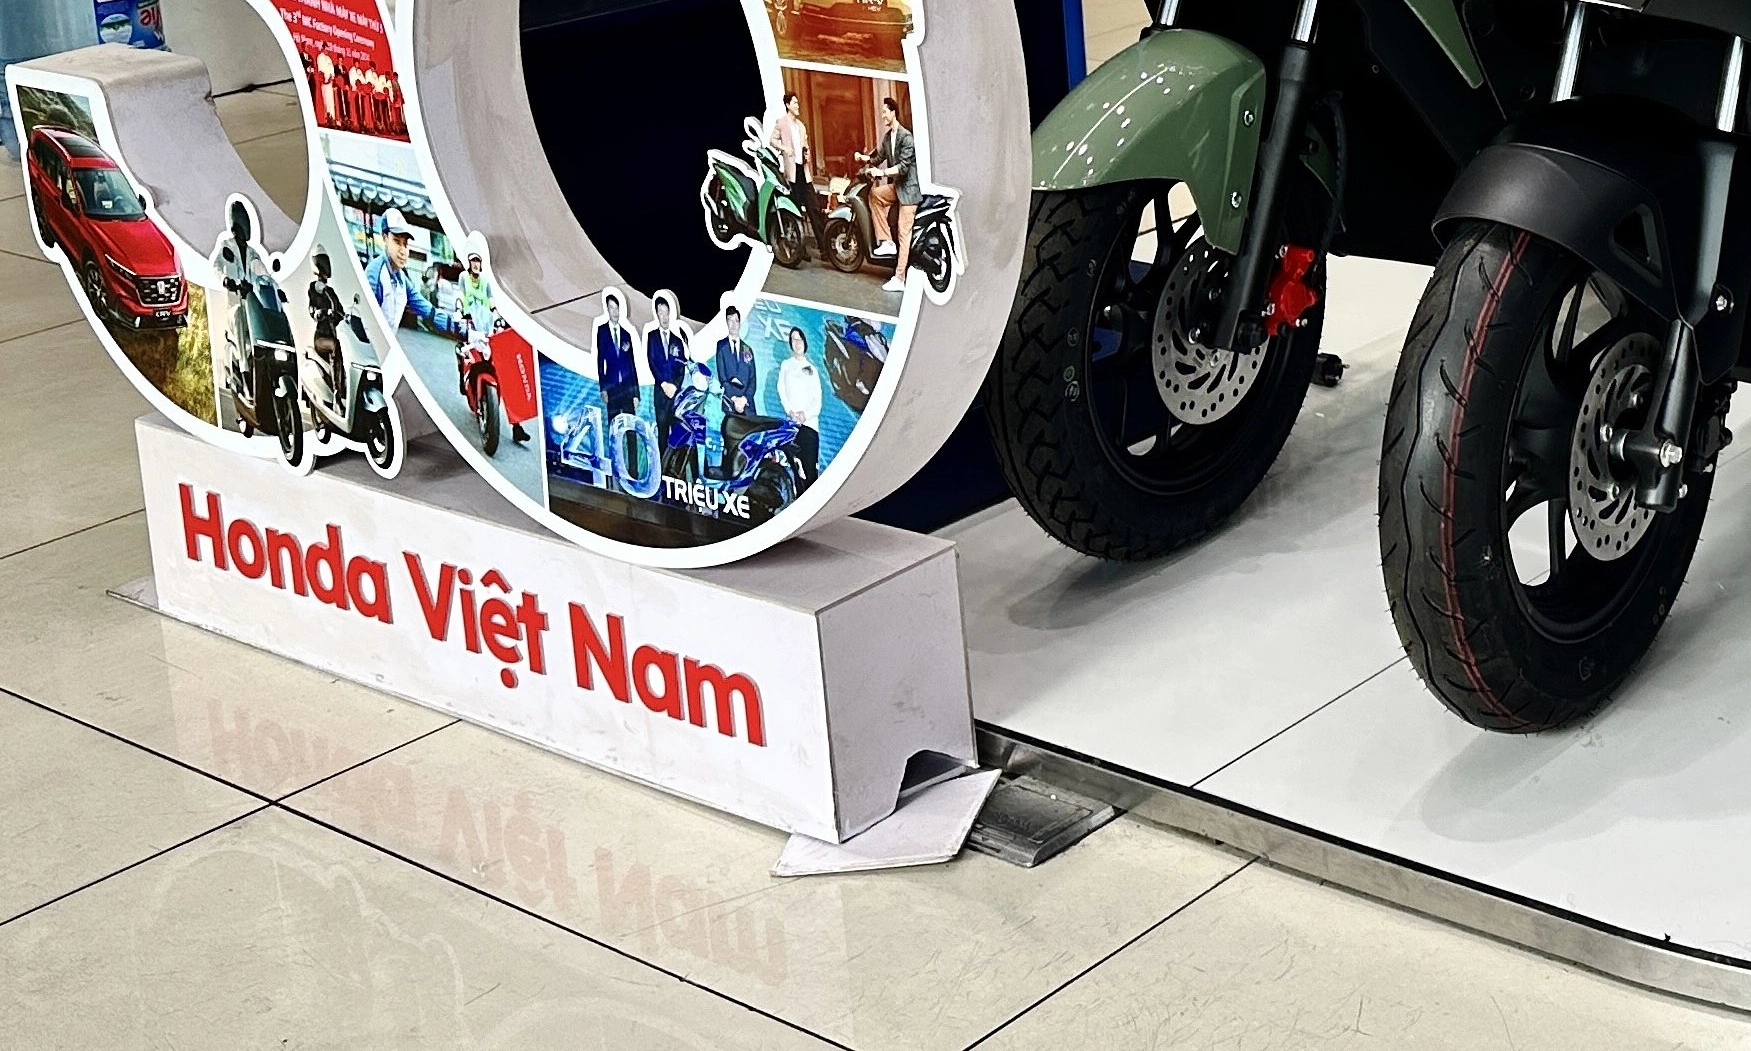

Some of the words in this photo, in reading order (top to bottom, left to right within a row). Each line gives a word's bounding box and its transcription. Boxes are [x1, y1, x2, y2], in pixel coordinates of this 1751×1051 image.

[515, 352, 532, 402] HONDA
[560, 404, 662, 499] 40
[662, 475, 719, 513] TRIỆU
[722, 490, 750, 520] XE
[177, 481, 394, 625] Honda
[402, 550, 549, 690] Việt
[568, 600, 767, 748] Nam
